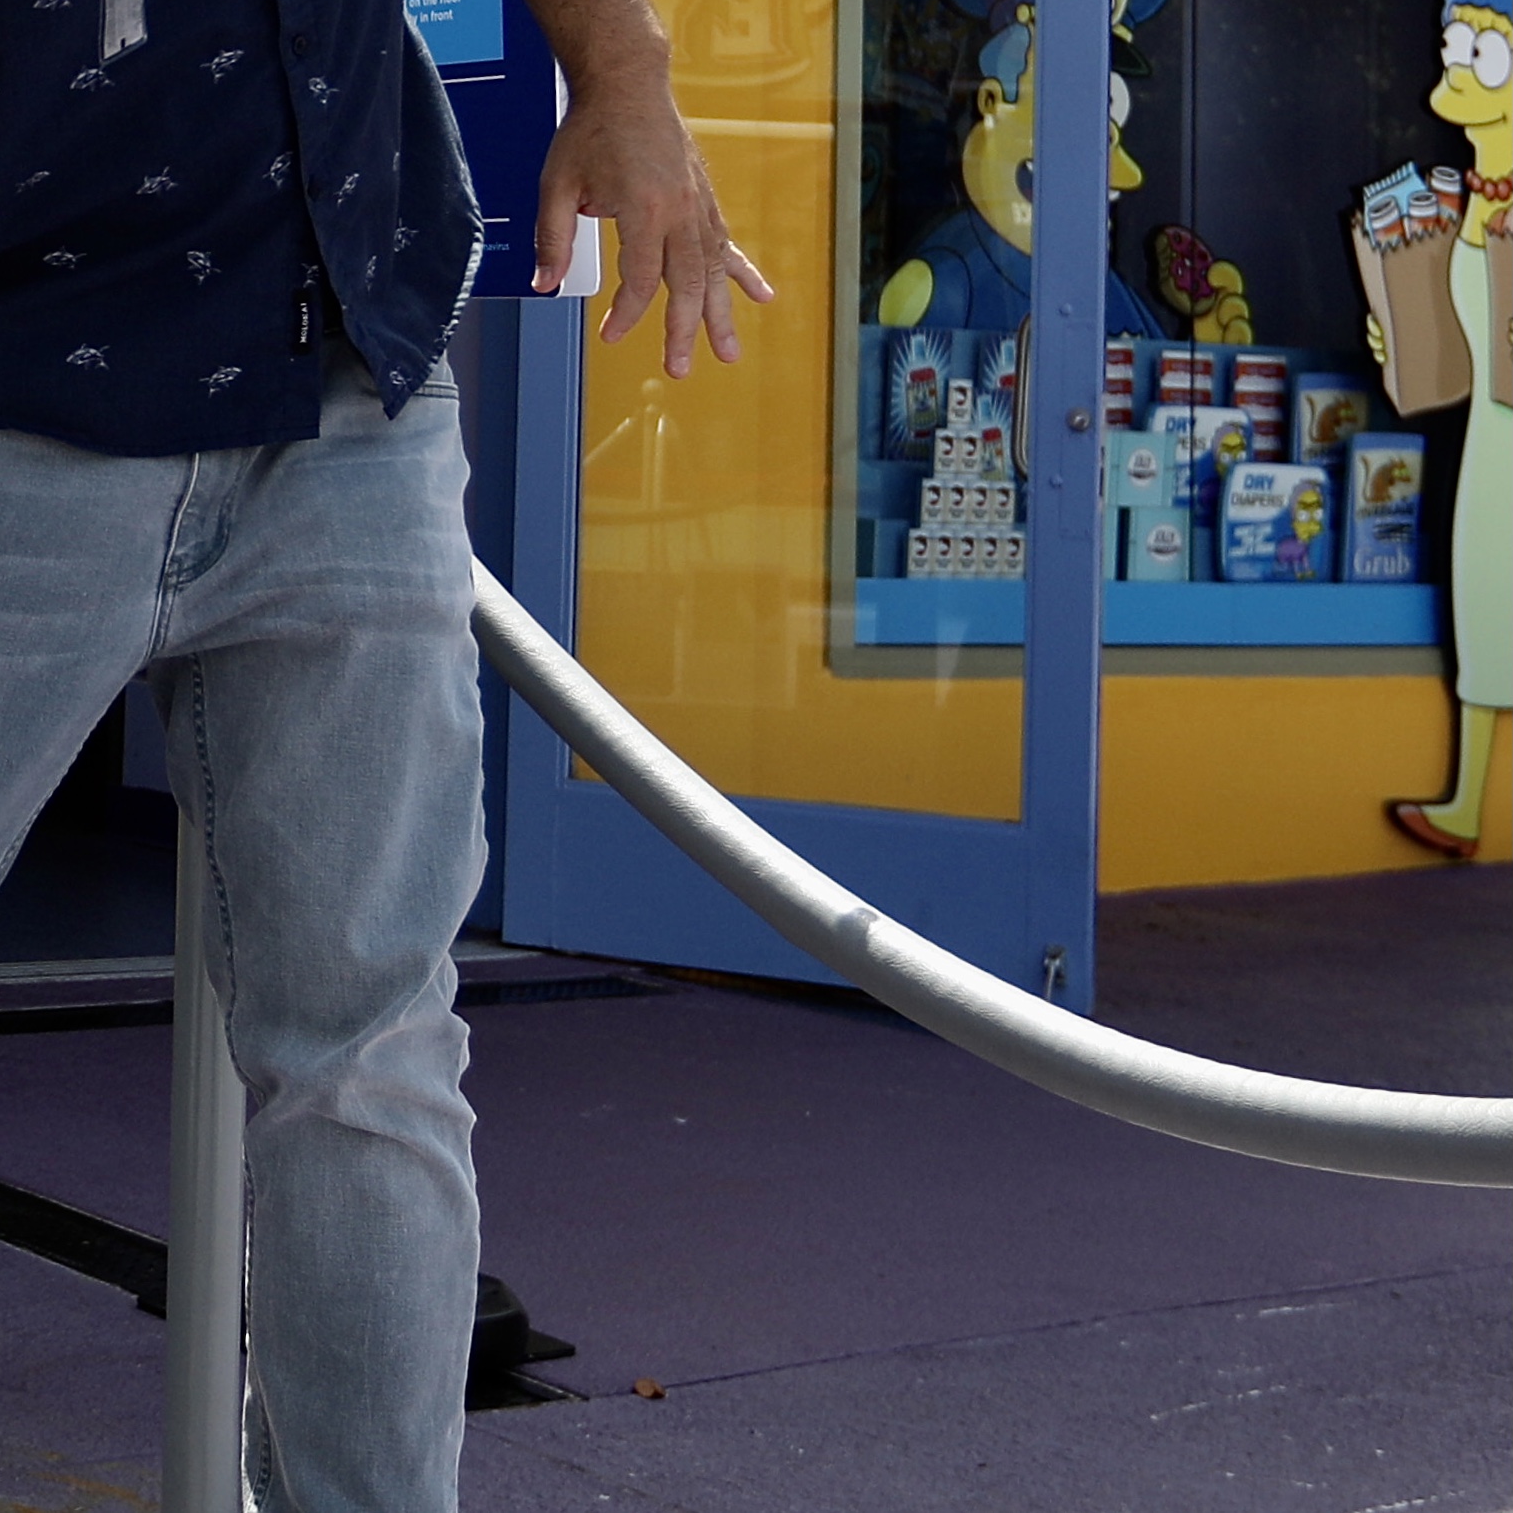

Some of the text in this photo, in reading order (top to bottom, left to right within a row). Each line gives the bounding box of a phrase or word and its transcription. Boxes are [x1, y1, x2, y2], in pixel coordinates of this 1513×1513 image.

[430, 9, 454, 22] front
[1244, 473, 1274, 490] DRY
[1230, 492, 1285, 508] DIAPERS
